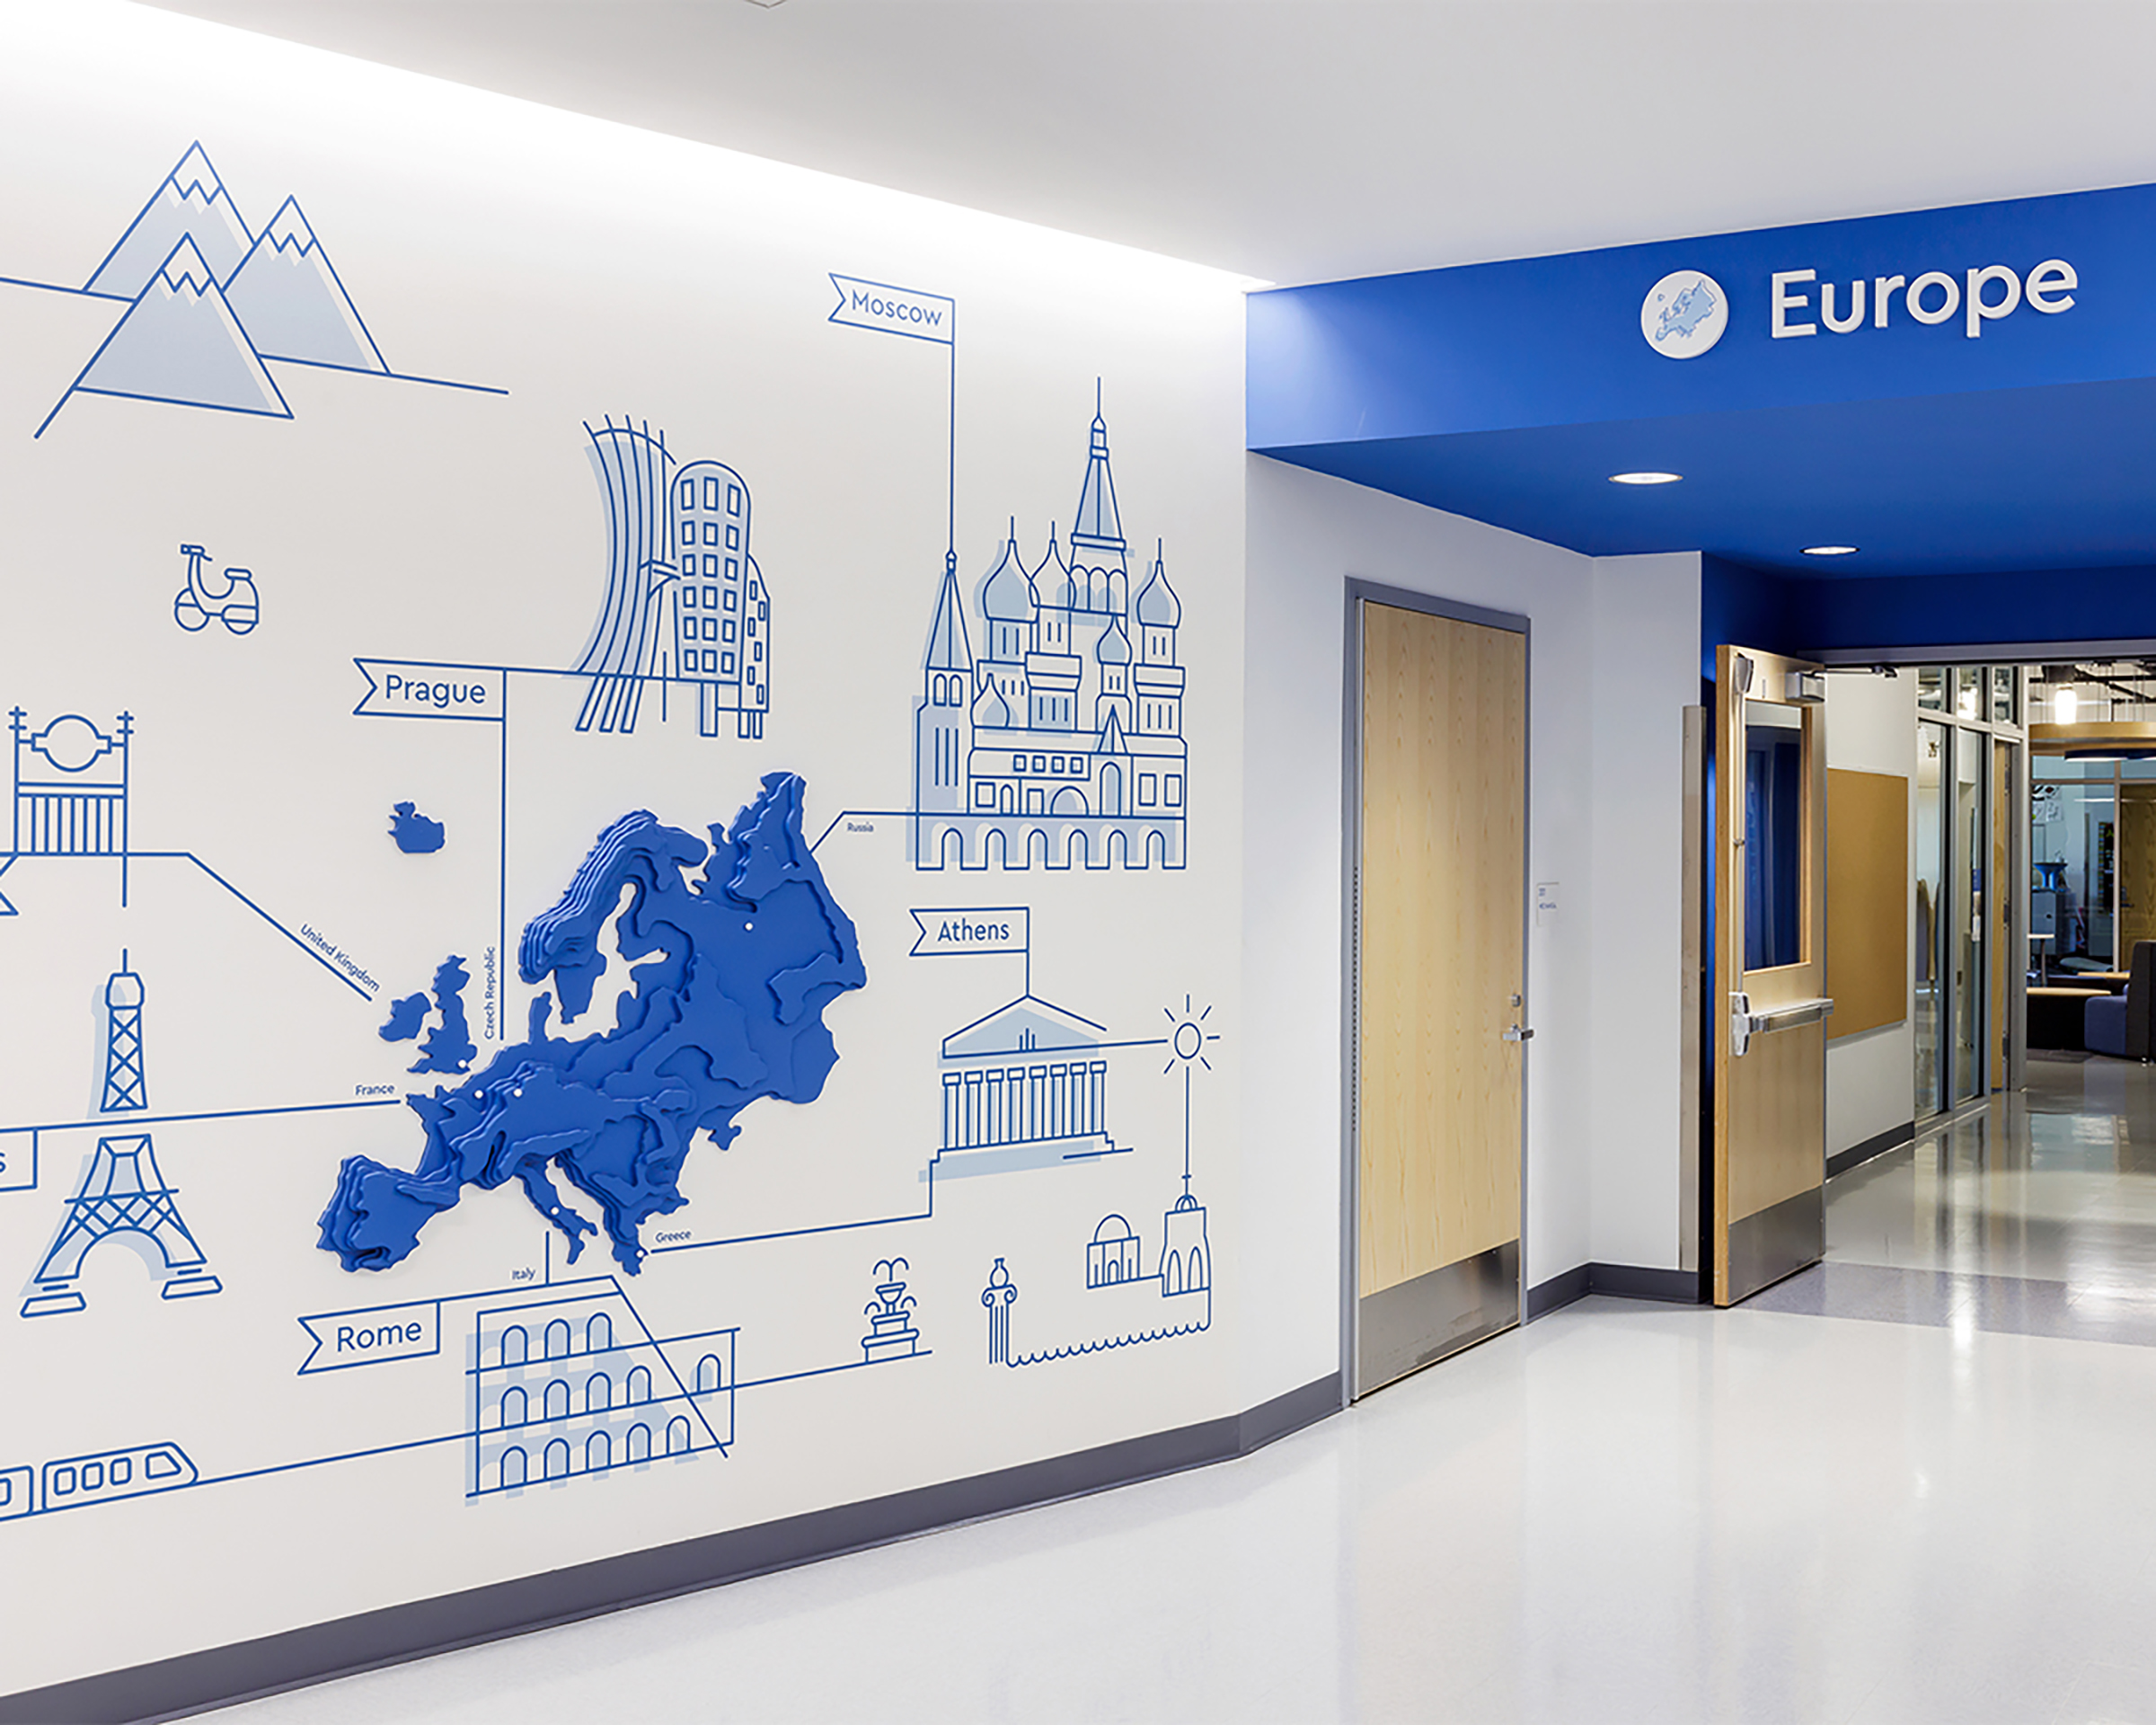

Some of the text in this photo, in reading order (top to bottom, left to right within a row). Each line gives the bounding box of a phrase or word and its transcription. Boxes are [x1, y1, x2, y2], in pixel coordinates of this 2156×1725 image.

[852, 288, 942, 326] Moscow
[1772, 258, 2078, 340] Europe
[385, 674, 486, 709] Prague
[846, 820, 875, 833] Russia
[937, 917, 1010, 942] Athens
[300, 923, 381, 993] United Kingdom
[483, 946, 497, 1040] Czech Republic
[355, 1084, 395, 1096] France
[655, 1230, 693, 1243] Greece
[511, 1266, 536, 1281] Italy
[337, 1322, 422, 1353] Rome
